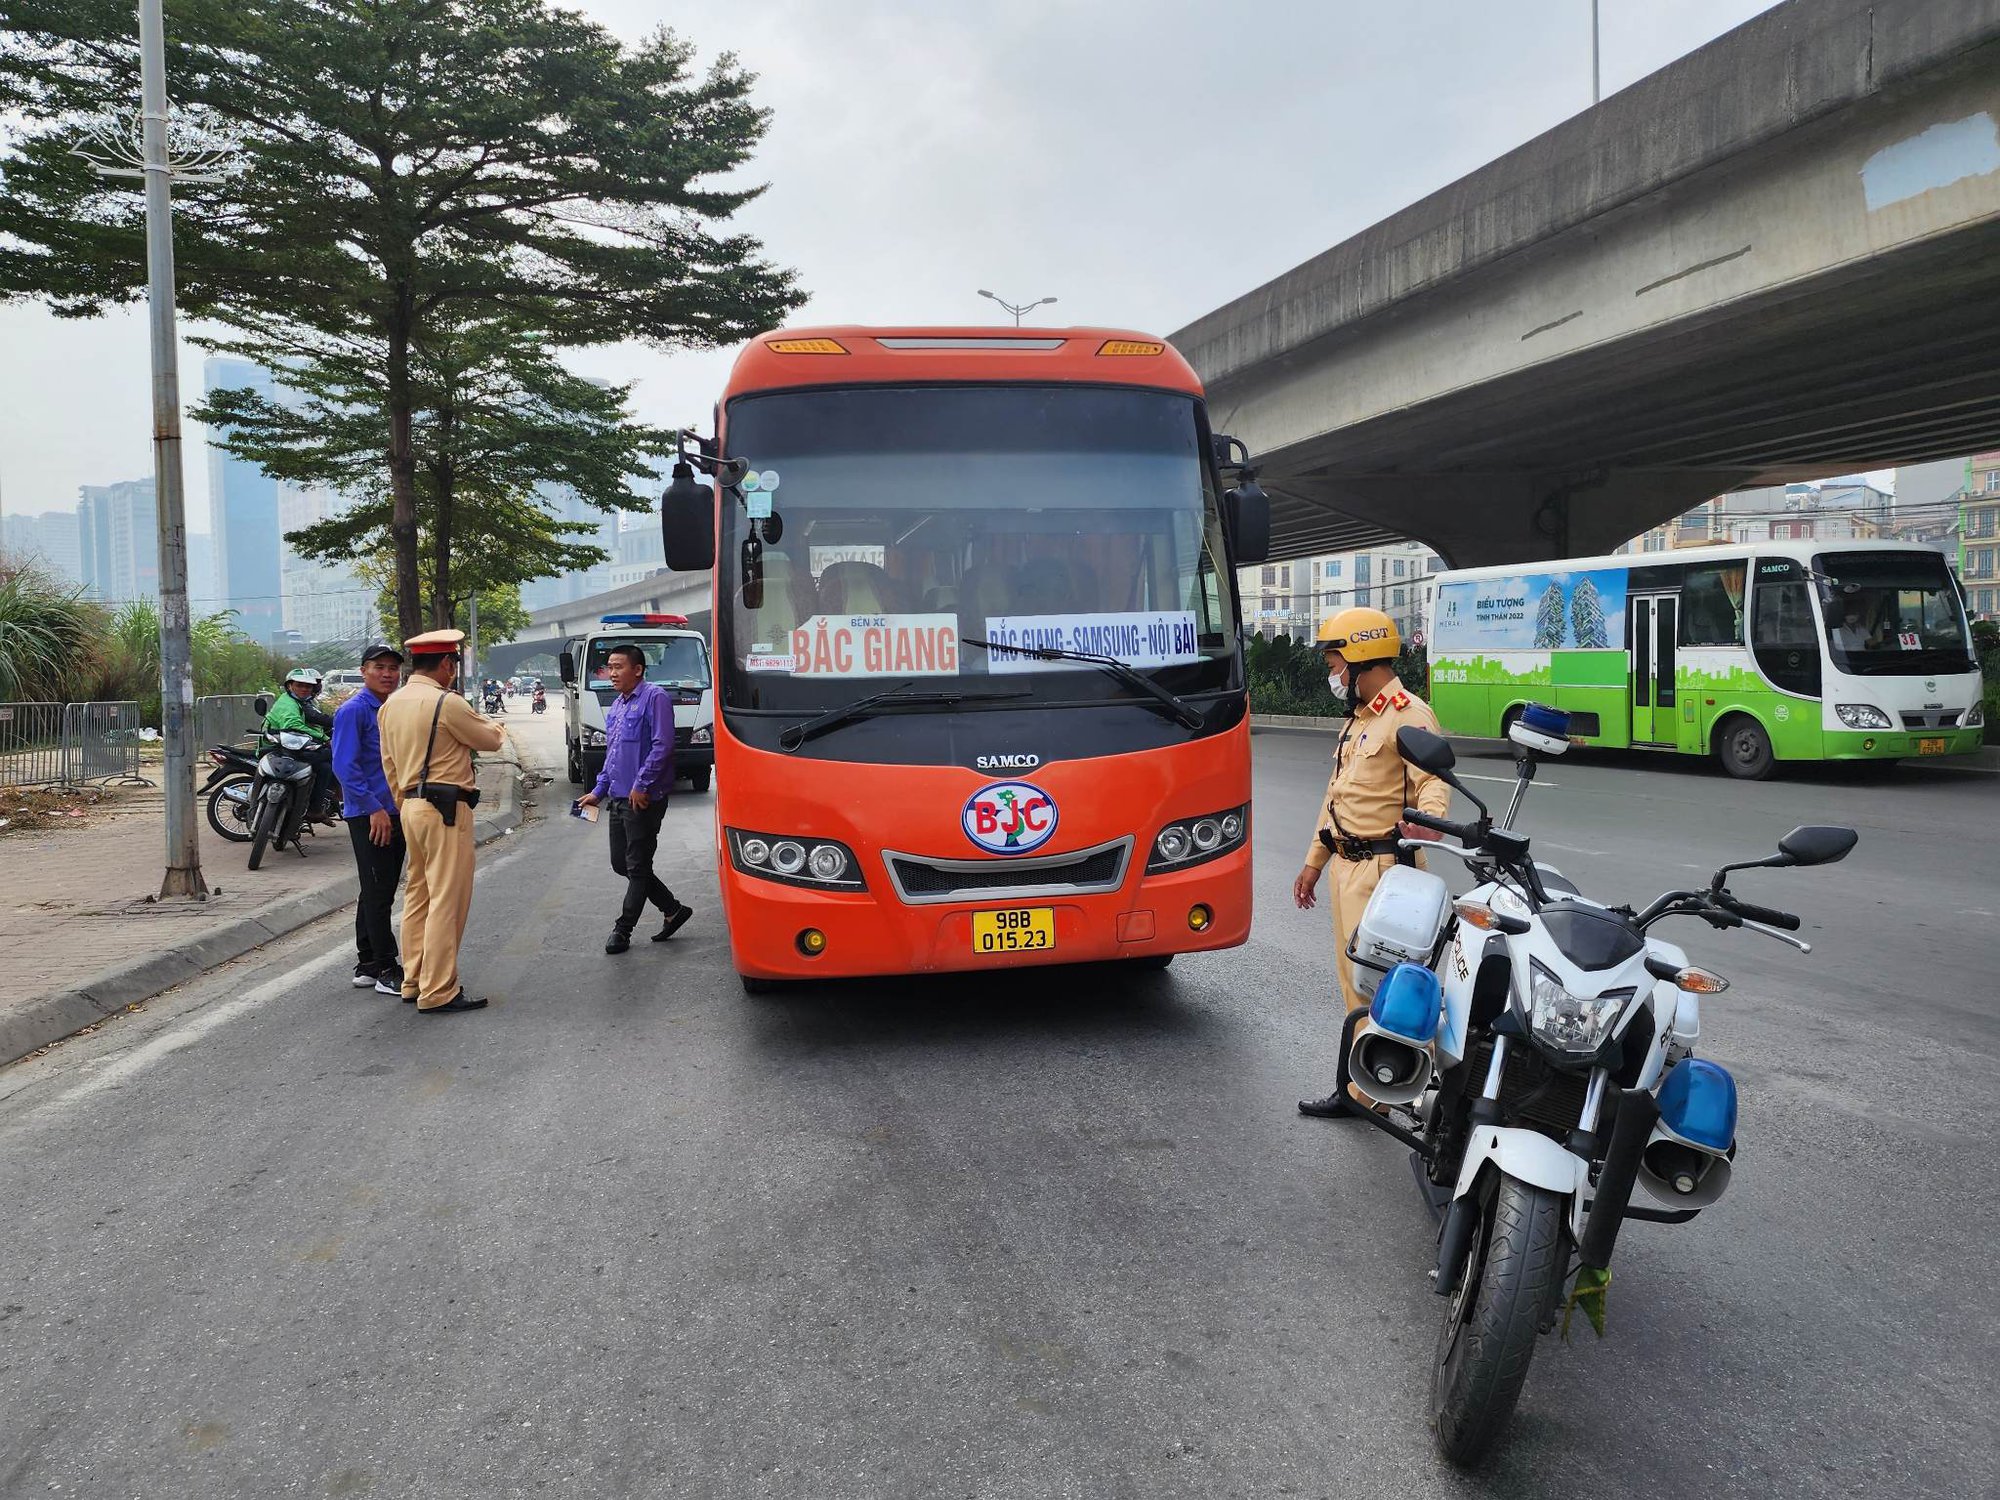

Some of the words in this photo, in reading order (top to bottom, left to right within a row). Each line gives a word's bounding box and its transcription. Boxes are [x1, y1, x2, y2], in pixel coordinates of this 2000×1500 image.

[1761, 564, 1790, 573] SAMCO
[1496, 597, 1525, 610] TƯỢNG
[1509, 612, 1525, 620] 2022
[792, 617, 852, 673] BẮC
[864, 627, 956, 673] GIANG
[990, 618, 1017, 662] BẮC
[1174, 616, 1195, 654] BÀI
[1350, 628, 1389, 643] CSGT
[976, 754, 1040, 768] SAMCO
[974, 797, 1048, 835] BJC
[996, 911, 1031, 930] 98B
[982, 930, 1046, 950] 015.23
[1454, 932, 1469, 982] POLICE
